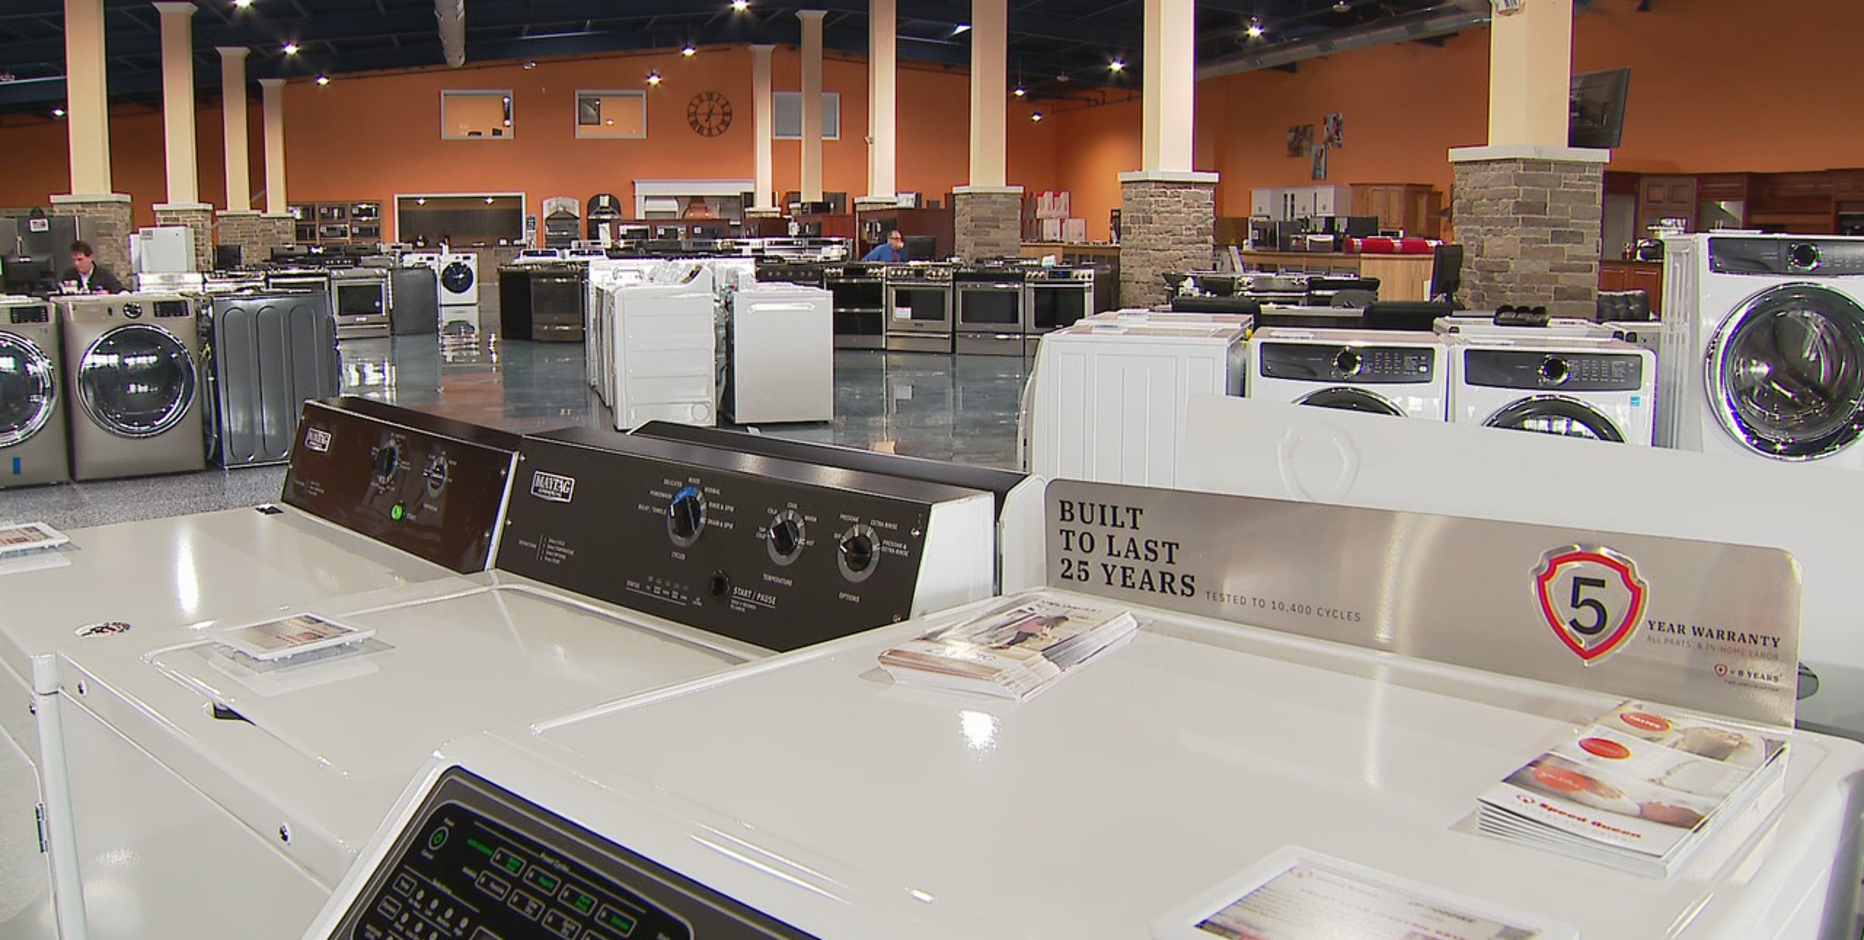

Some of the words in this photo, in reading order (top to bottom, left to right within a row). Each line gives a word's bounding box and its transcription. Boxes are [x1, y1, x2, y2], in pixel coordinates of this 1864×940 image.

[535, 474, 571, 494] MAYTAG
[1059, 500, 1144, 530] BUILT
[1060, 529, 1095, 554] TO
[1106, 534, 1180, 565] LAST
[1060, 557, 1091, 582] 25
[1100, 563, 1196, 598] YEARS
[733, 586, 751, 600] START
[756, 592, 777, 606] PAUSE
[838, 591, 860, 603] OPTIONS
[1205, 591, 1247, 606] TESTED
[1251, 597, 1266, 609] TO
[1271, 601, 1312, 616] 10,400
[1316, 606, 1362, 622] CYCLES
[1569, 576, 1608, 636] 5
[1647, 620, 1686, 635] YEAR
[1691, 625, 1781, 648] WARRANTY
[1647, 635, 1662, 645] ALL
[1705, 642, 1745, 656] IN-HOME
[1748, 648, 1779, 660] LABOR
[1539, 802, 1588, 823] Speed
[1591, 820, 1642, 839] Queen
